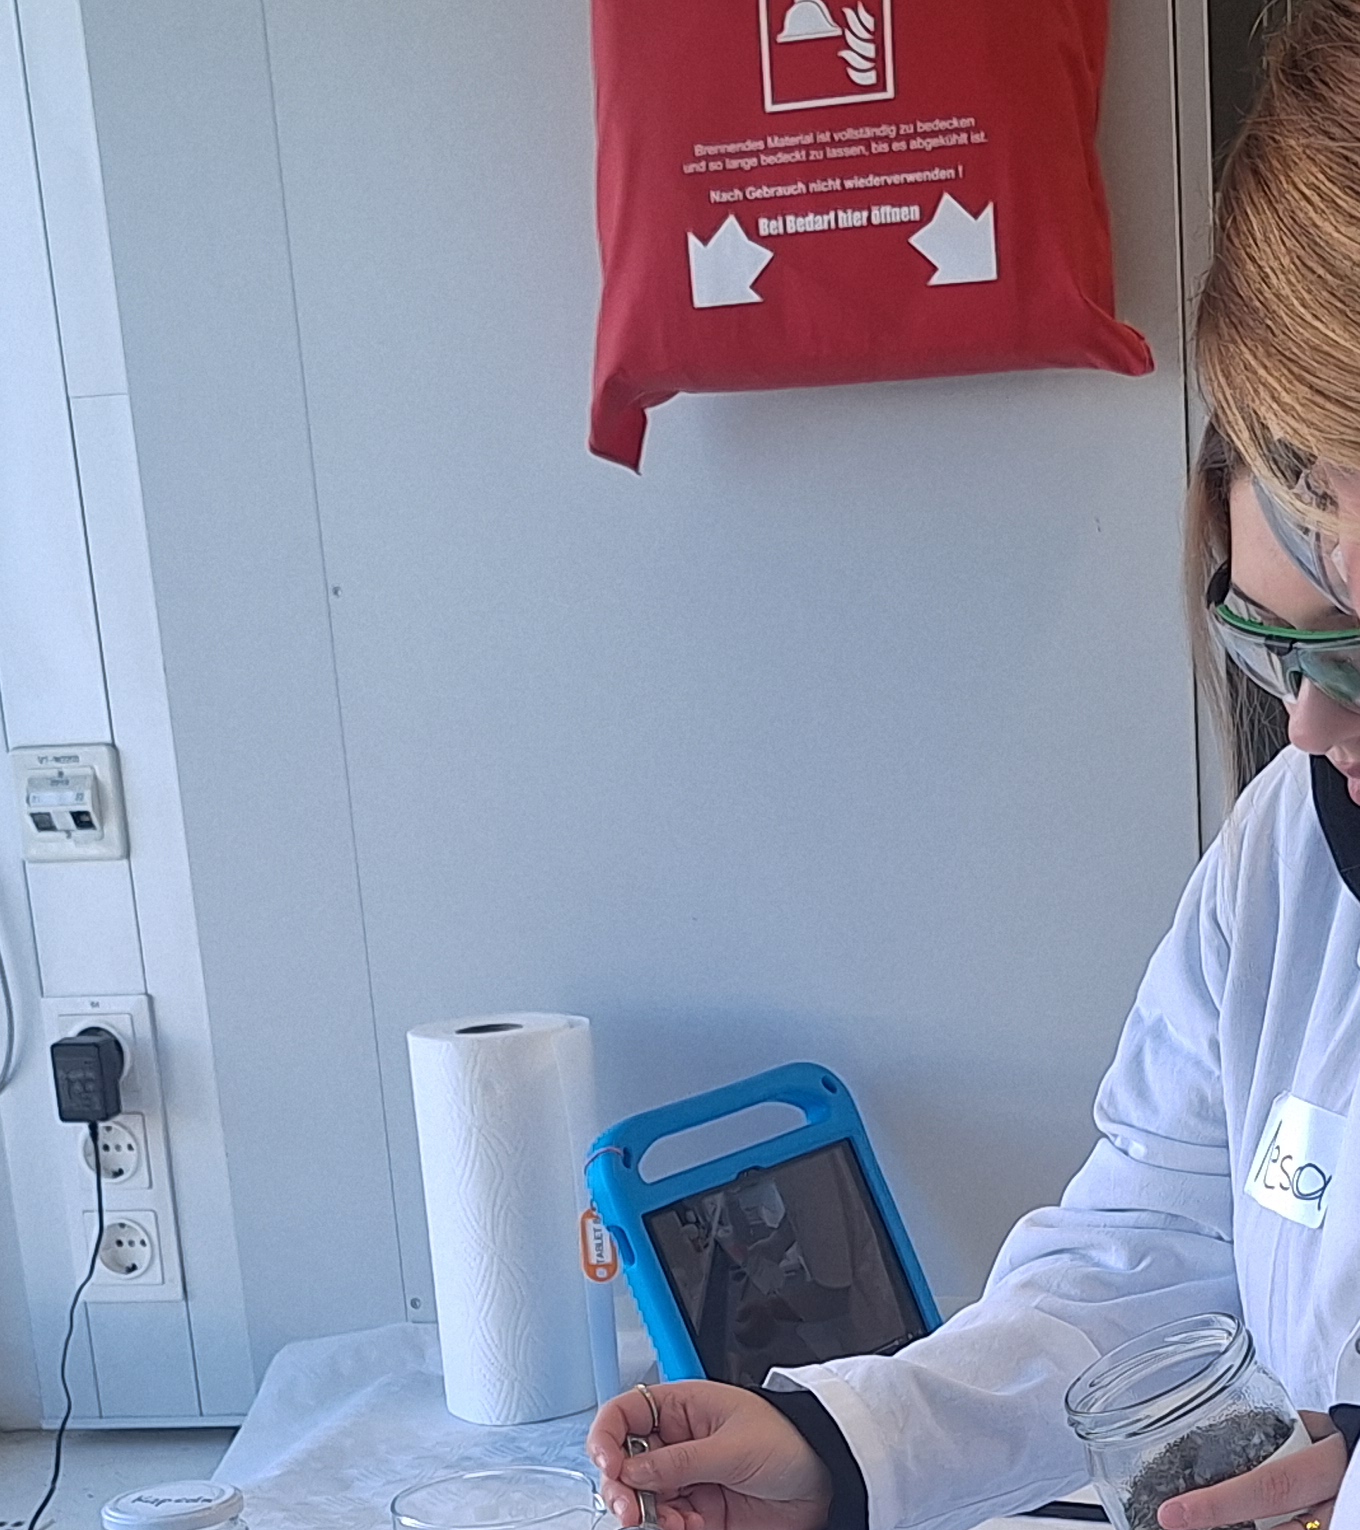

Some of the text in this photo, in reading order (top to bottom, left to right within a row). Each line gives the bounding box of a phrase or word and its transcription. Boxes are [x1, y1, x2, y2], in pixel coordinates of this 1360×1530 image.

[683, 160, 705, 175] und
[709, 159, 722, 173] so
[726, 155, 757, 171] lange
[760, 150, 806, 167] bedeckt
[809, 148, 823, 162] zu
[826, 143, 868, 160] lassen,
[871, 141, 888, 155] bis
[892, 139, 906, 153] es
[910, 132, 968, 151] abgekühlt
[694, 115, 974, 158] Brennendes Material ist vollständig zu bedecken
[710, 187, 742, 204] Nach
[745, 180, 806, 200] Gebrauch
[808, 177, 841, 193] nicht
[844, 164, 954, 190] wiederverwenden
[759, 200, 919, 237] Bei Bedarf hier öffnen
